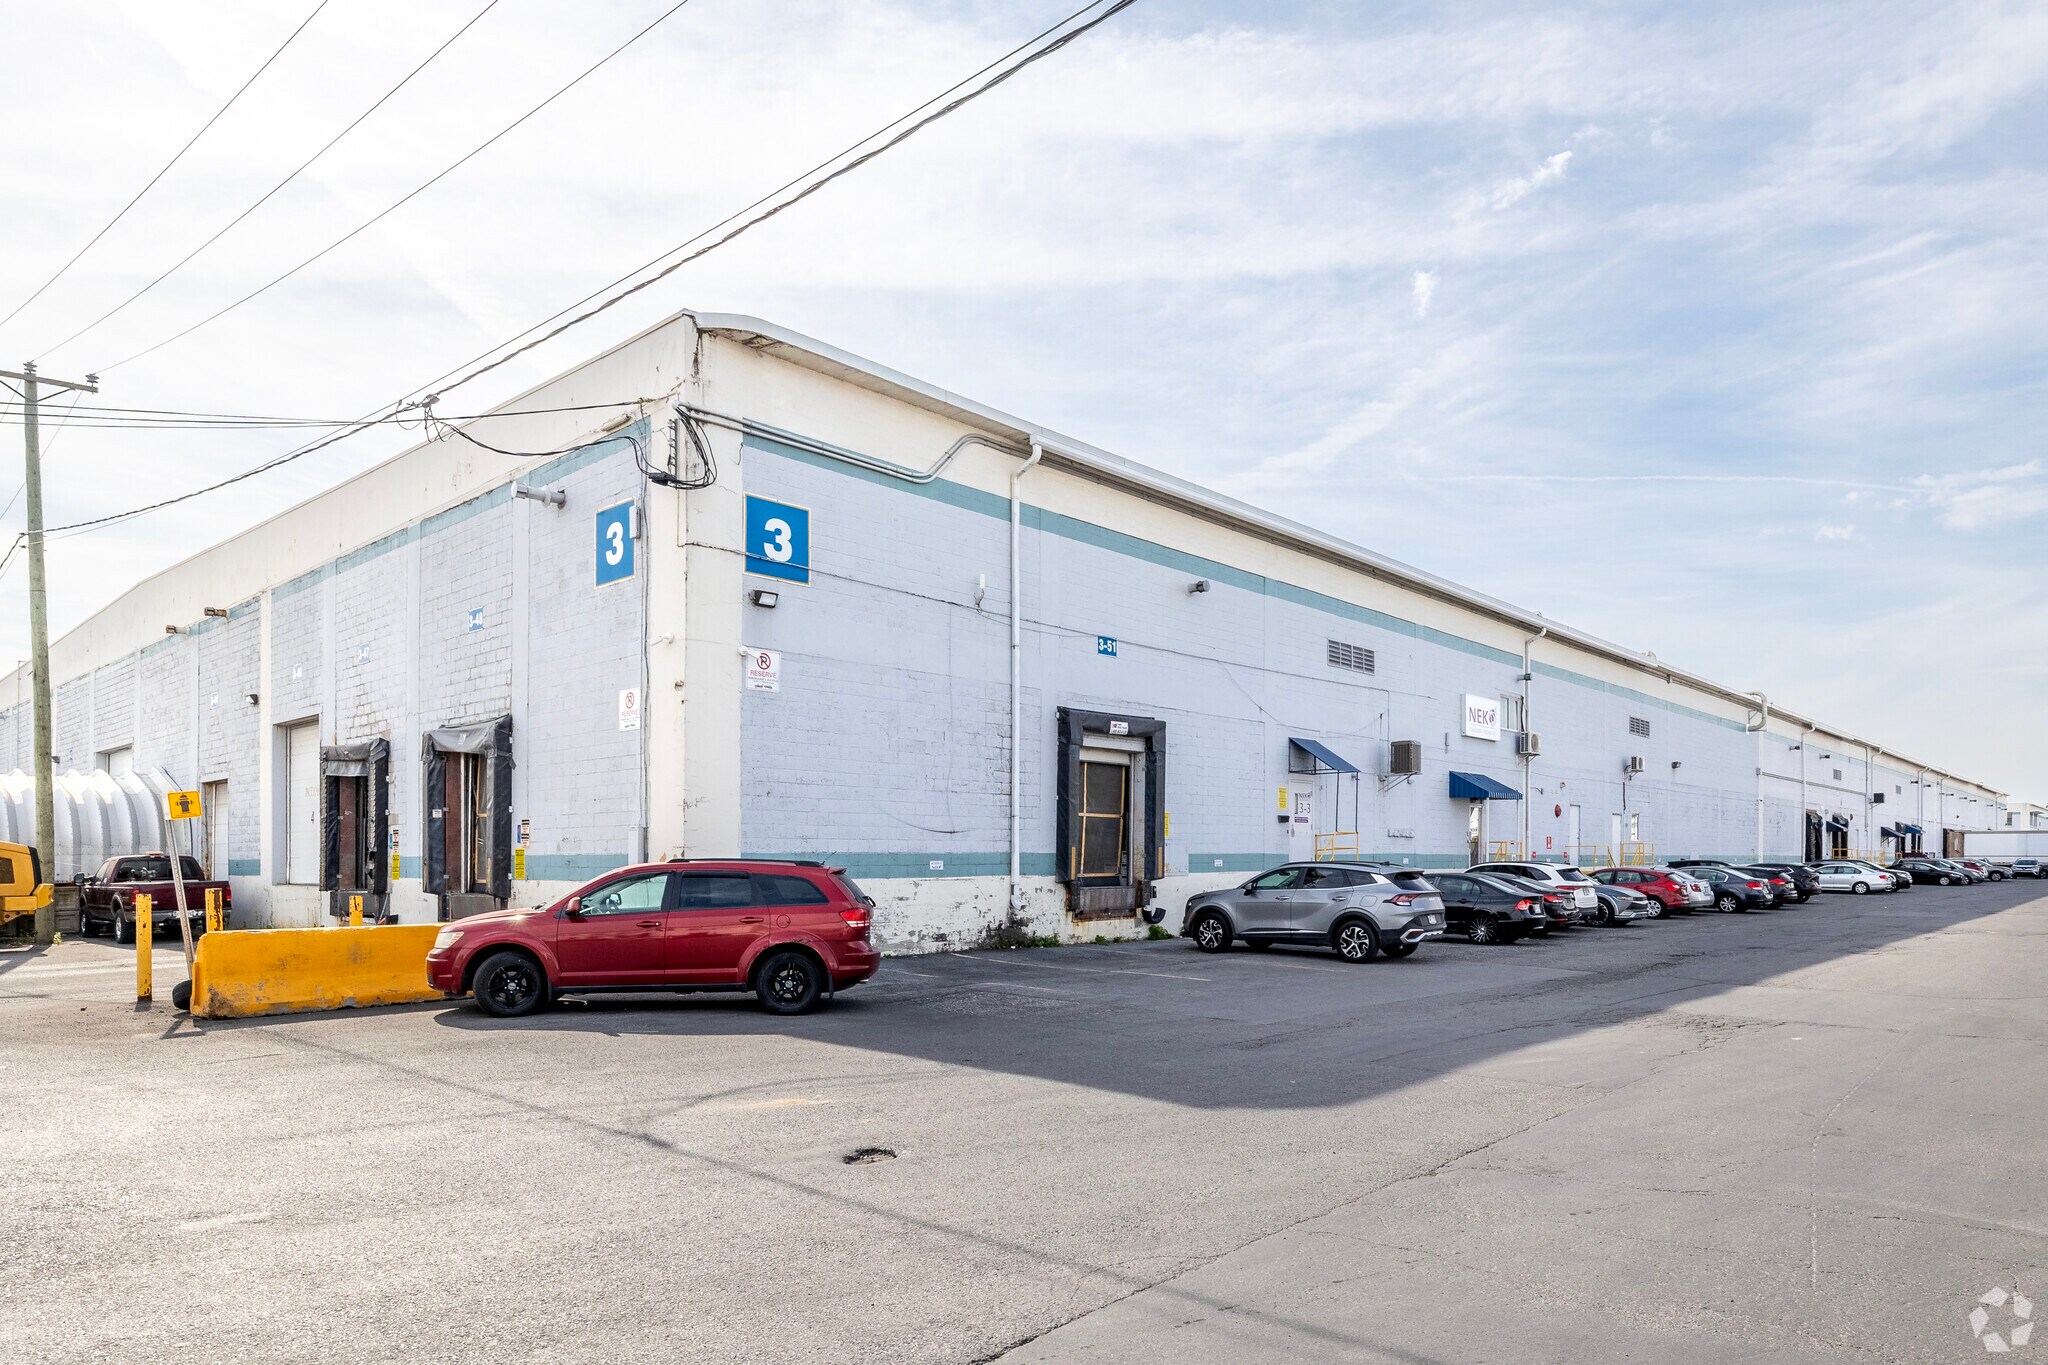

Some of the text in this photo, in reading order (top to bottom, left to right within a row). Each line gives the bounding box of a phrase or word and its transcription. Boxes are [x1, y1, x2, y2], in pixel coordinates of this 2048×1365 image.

[605, 521, 624, 566] 3
[763, 518, 793, 562] 3
[1098, 638, 1116, 653] 3-51
[1299, 802, 1311, 814] 3-3
